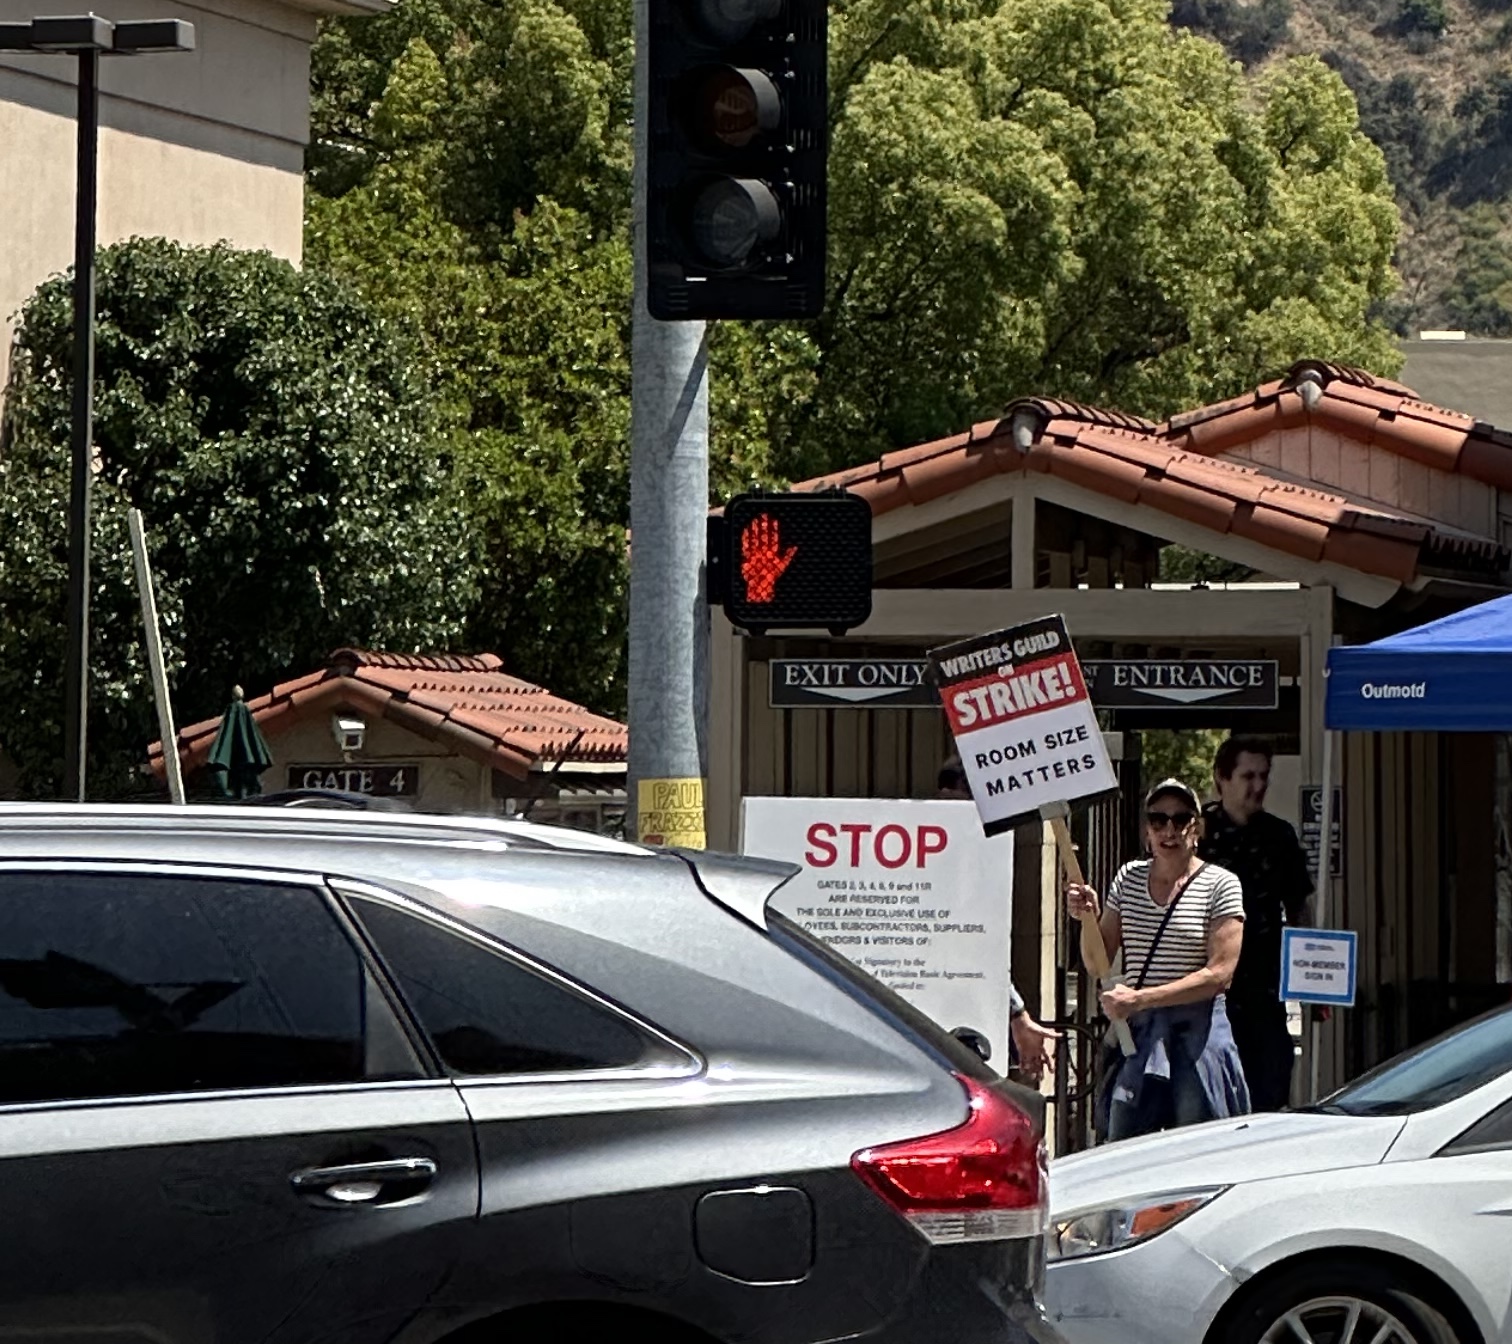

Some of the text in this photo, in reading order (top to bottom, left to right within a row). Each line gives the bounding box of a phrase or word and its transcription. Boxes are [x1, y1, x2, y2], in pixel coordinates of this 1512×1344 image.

[940, 631, 1060, 678] WRITERS GUILD
[784, 664, 928, 686] EXIT ONLY
[1113, 665, 1264, 686] ENTRANCE
[953, 662, 1077, 727] STRIKE!
[975, 724, 1090, 769] ROOM SIZE
[303, 769, 405, 793] GATE 4
[985, 754, 1096, 797] MATTERS
[804, 822, 948, 869] STOP
[817, 880, 847, 889] GATES
[828, 894, 920, 904] ARE RESERVED FOR
[797, 907, 814, 917] THE
[842, 908, 863, 917] AND
[865, 909, 915, 918] EXCLUSIVE
[937, 909, 951, 919] OF
